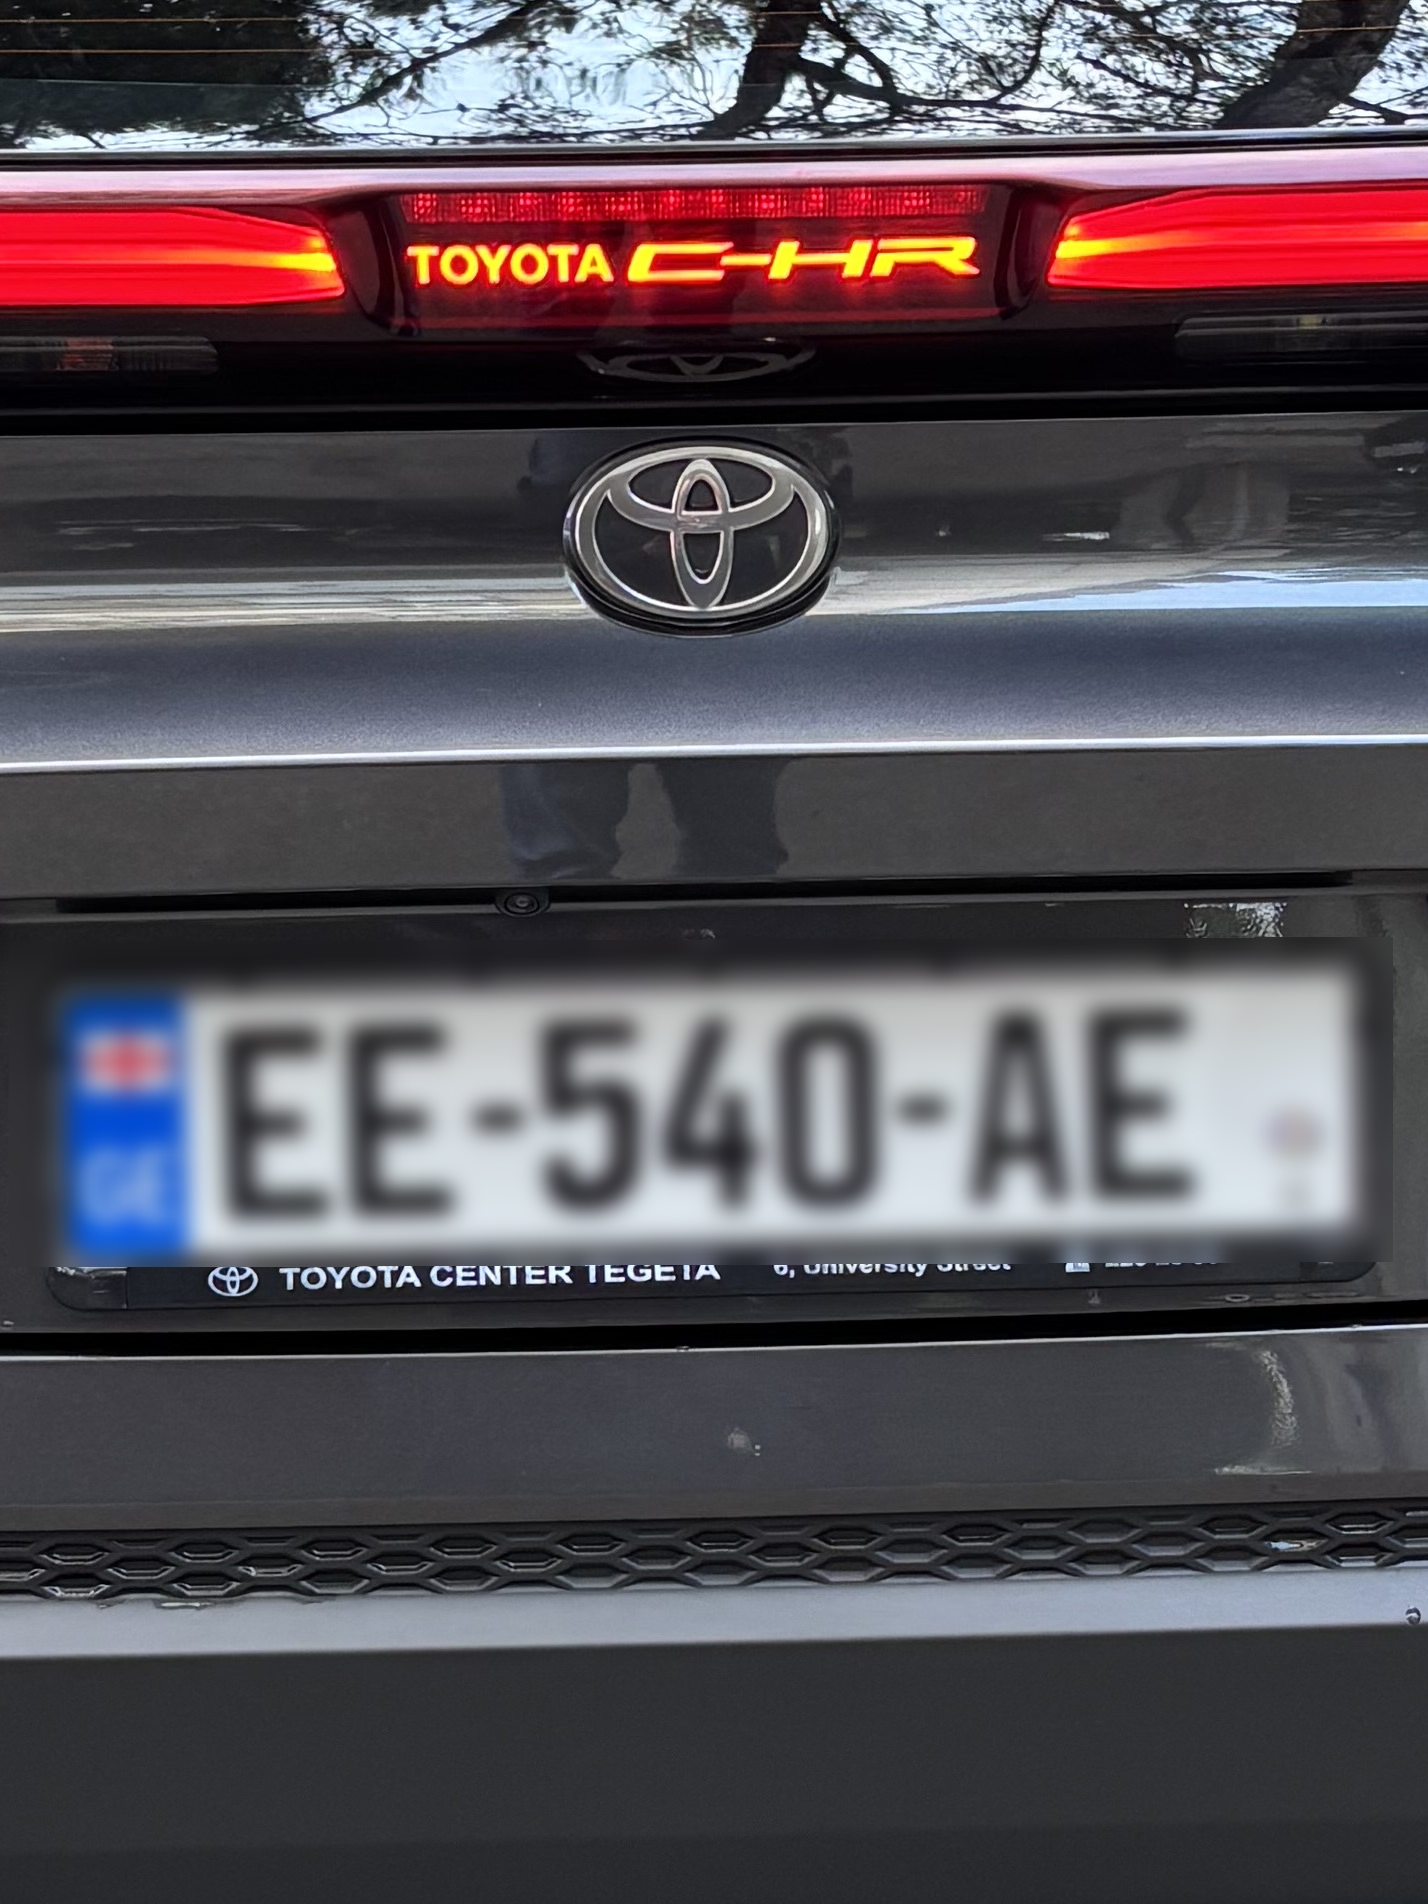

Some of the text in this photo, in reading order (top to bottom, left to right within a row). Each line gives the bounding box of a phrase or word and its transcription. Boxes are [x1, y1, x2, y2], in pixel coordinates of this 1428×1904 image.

[406, 236, 981, 285] TOYOTA C-HR
[278, 1264, 722, 1291] TOYOTA CENTER TEGETA
